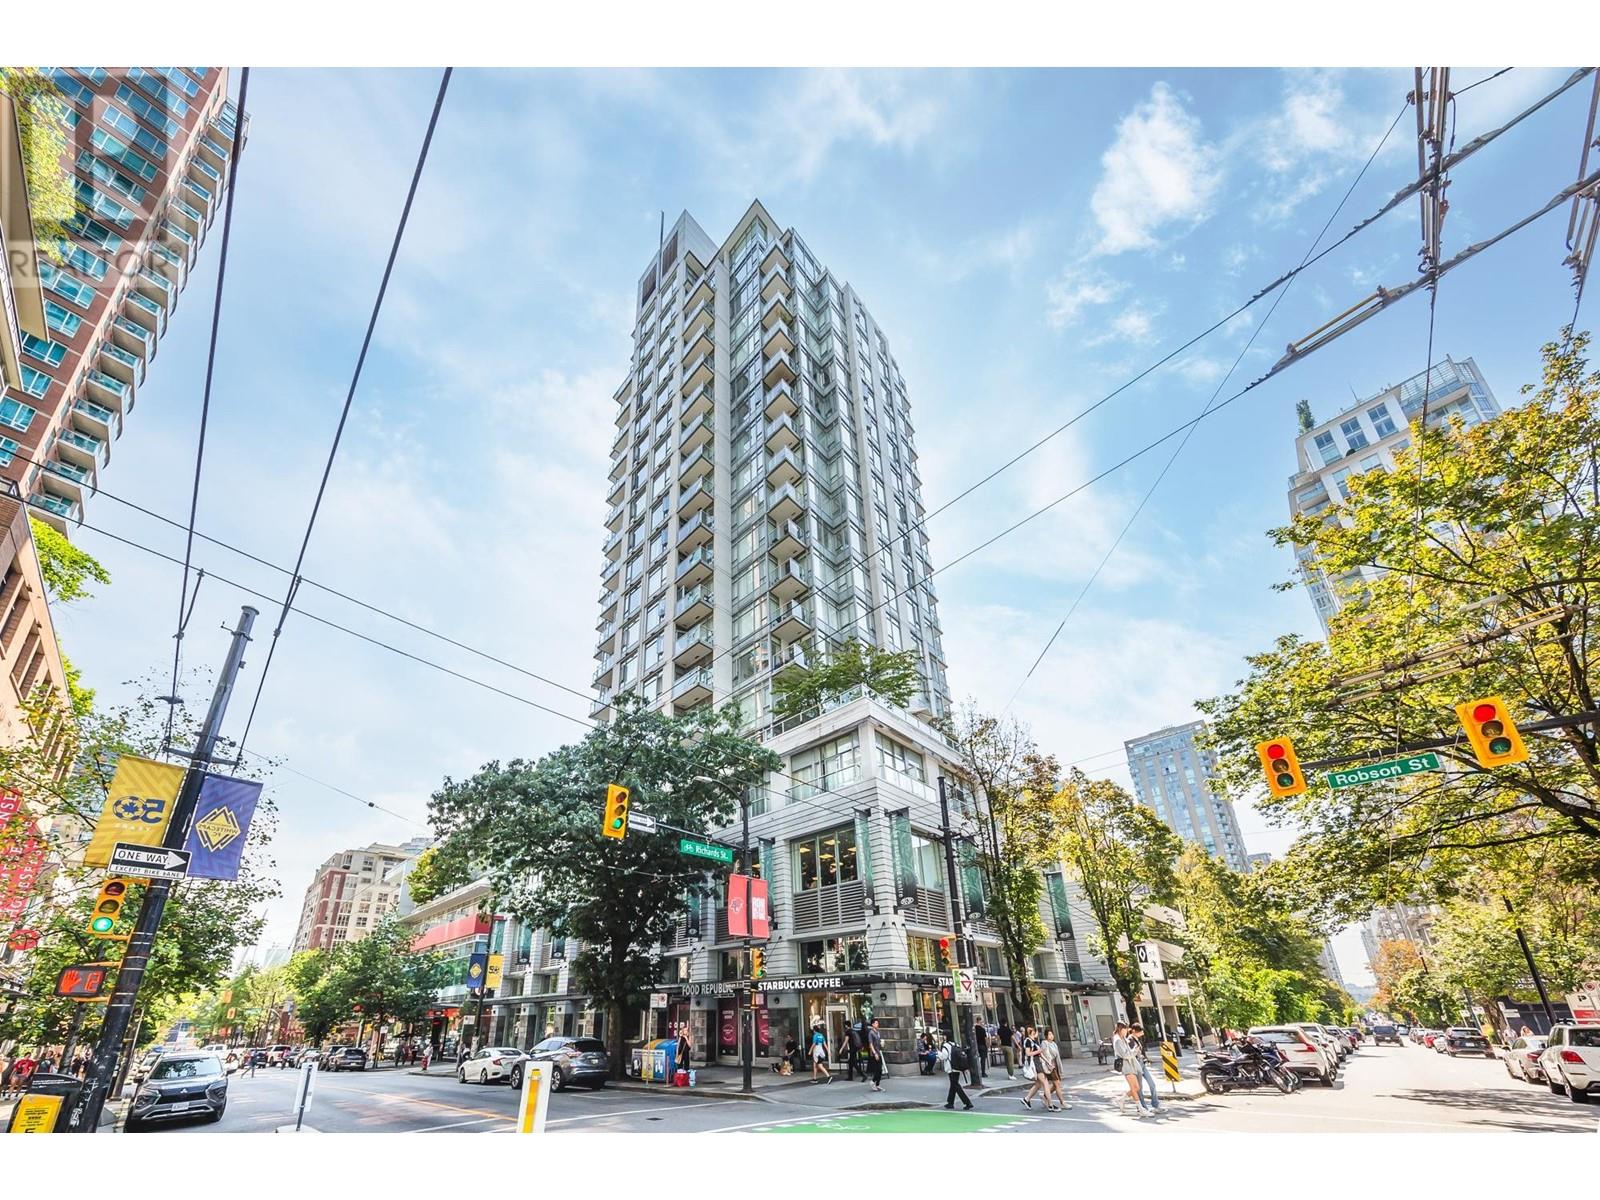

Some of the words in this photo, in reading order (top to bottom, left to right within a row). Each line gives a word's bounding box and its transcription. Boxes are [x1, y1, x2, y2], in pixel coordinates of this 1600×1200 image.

[1335, 765, 1402, 785] Robson
[1408, 758, 1431, 771] St
[118, 850, 141, 860] ONE
[146, 853, 168, 864] WAY
[696, 845, 720, 858] Richards
[115, 865, 141, 873] EXCEPT
[682, 984, 700, 996] FOOD
[701, 982, 734, 995] REPUBLIC
[757, 979, 805, 991] STARBUCKS
[806, 977, 841, 989] COFFEE
